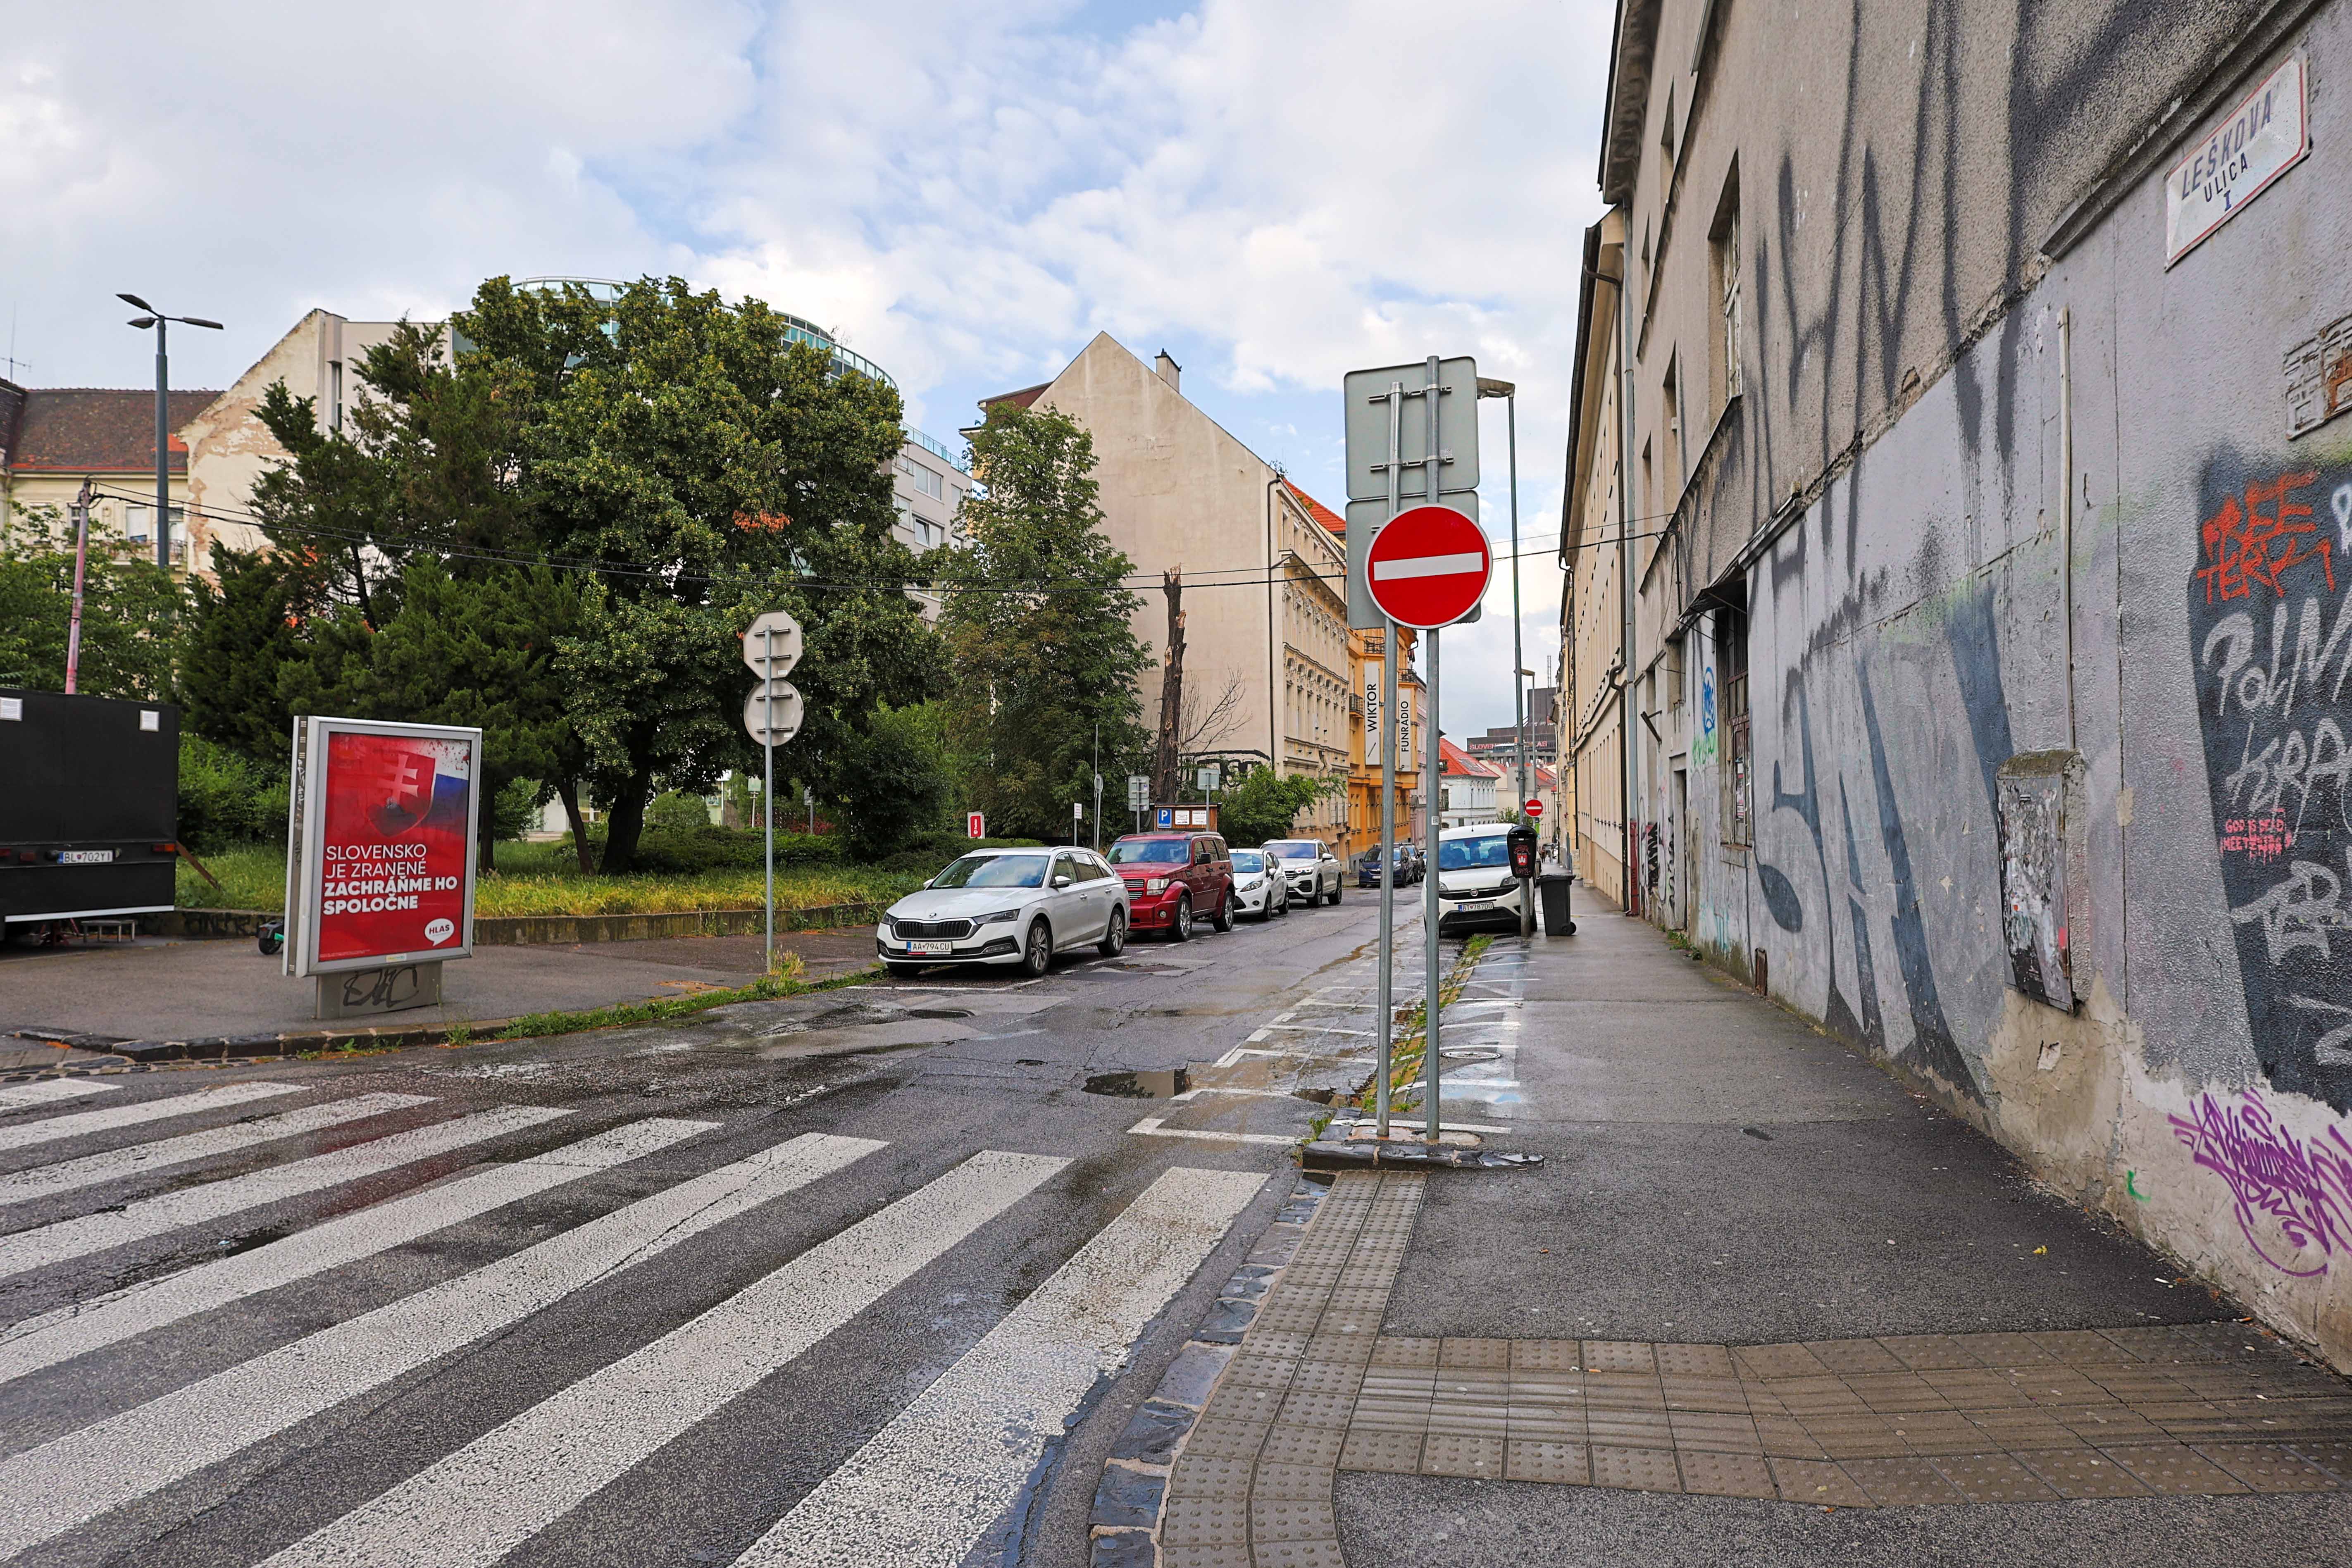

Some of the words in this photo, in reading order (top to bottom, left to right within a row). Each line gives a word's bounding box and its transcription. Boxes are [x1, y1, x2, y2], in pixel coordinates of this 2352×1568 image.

[2182, 90, 2271, 200] LEŠKOVA
[2204, 152, 2248, 203] ULICA
[1367, 683, 1377, 732] WIKTOR
[1161, 810, 1168, 821] P
[2225, 819, 2245, 833] GOD
[325, 844, 427, 860] SLOVENSKO
[325, 863, 346, 879] JE
[351, 858, 427, 878] ZRANENÉ
[324, 875, 432, 897] ZACHRÁŇME
[434, 876, 458, 890] HO
[323, 893, 419, 915] SPOLOČNE
[429, 924, 450, 934] HLAS
